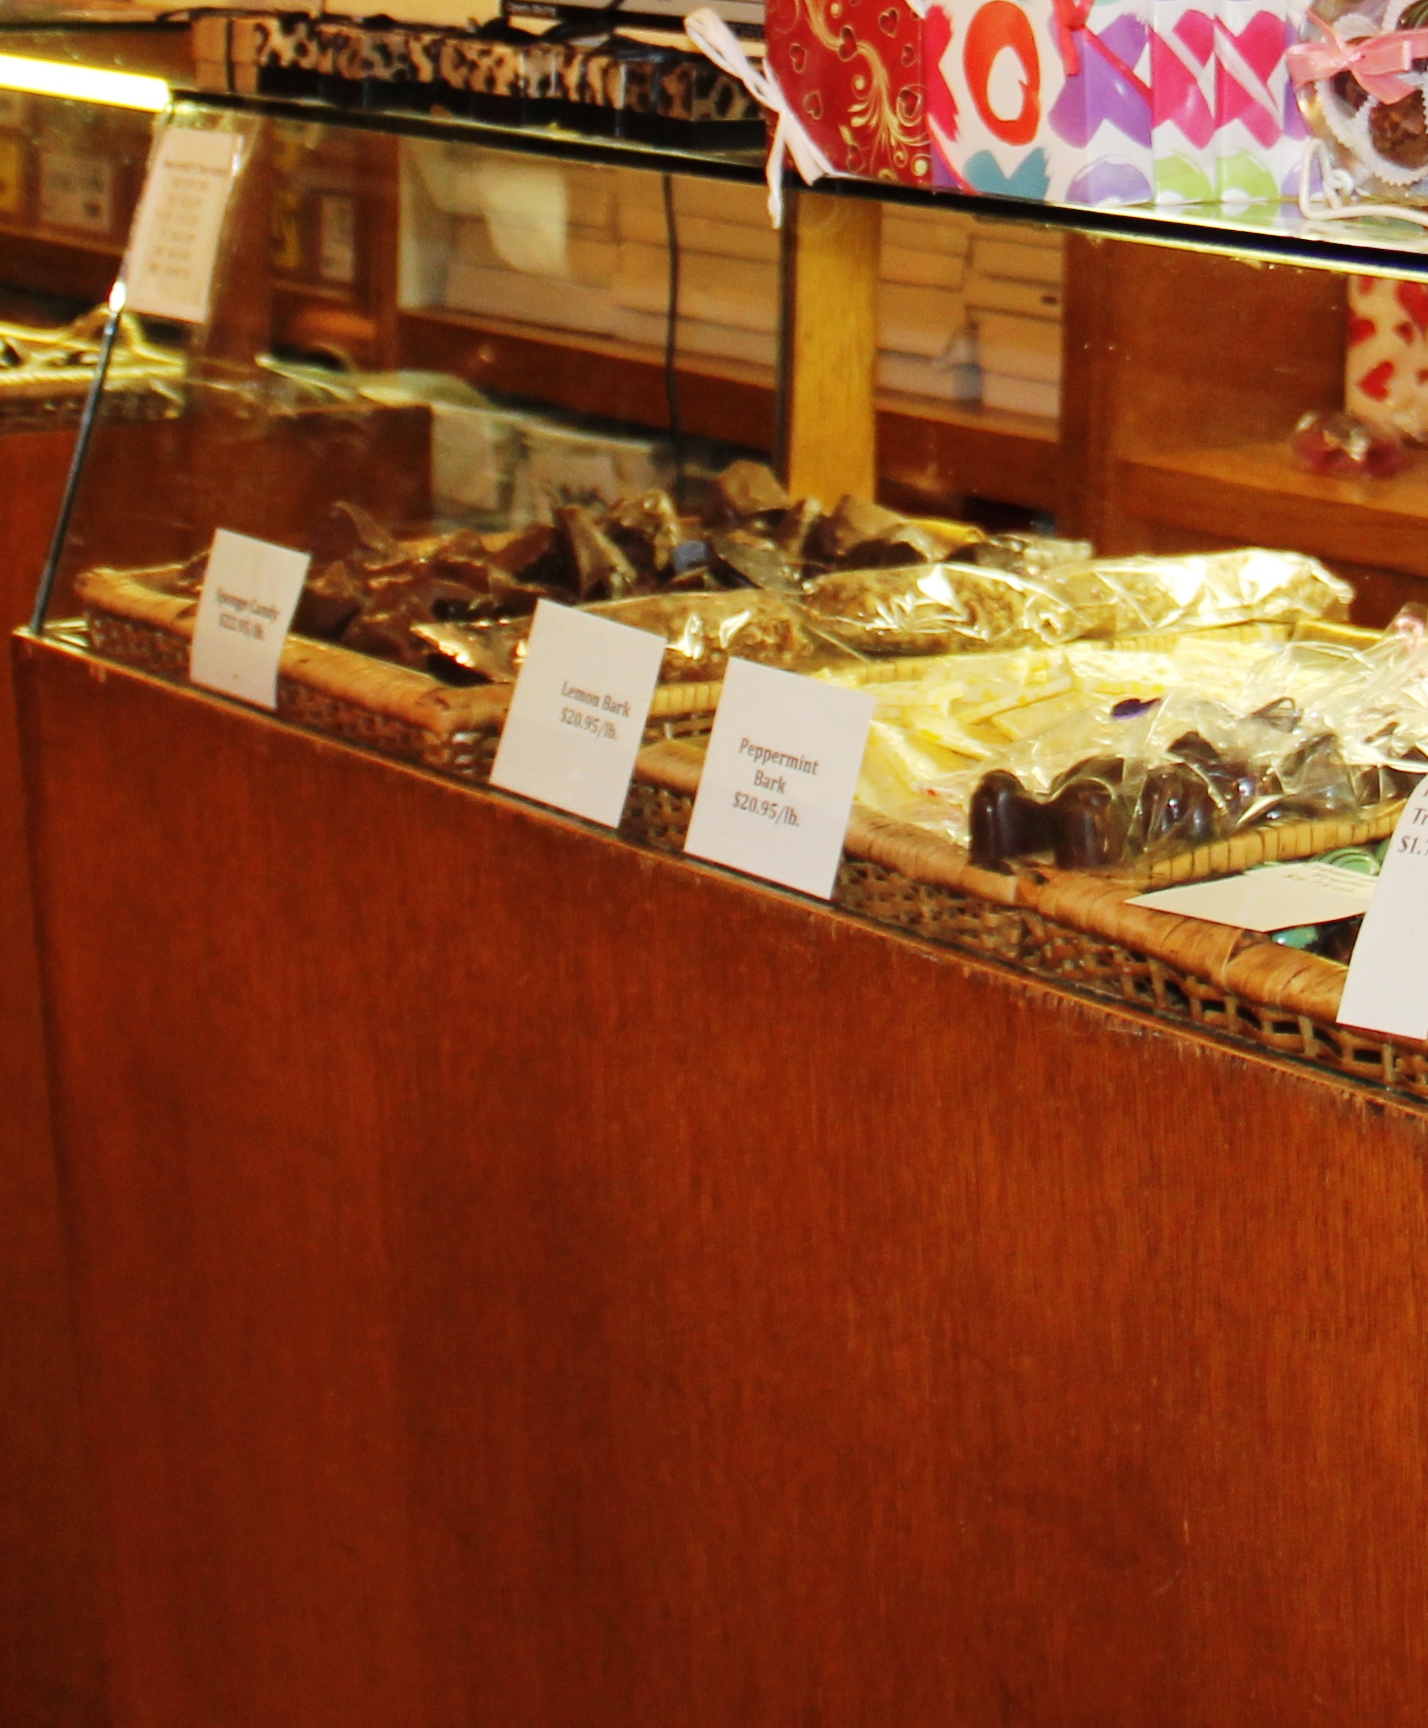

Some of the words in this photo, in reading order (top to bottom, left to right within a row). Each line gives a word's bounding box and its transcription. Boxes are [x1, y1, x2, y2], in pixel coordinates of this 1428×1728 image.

[560, 681, 600, 707] Lemon
[601, 695, 631, 718] Bark
[739, 737, 820, 776] Peppermint
[753, 770, 787, 795] Bark
[732, 790, 800, 827] $20.95/lb.
